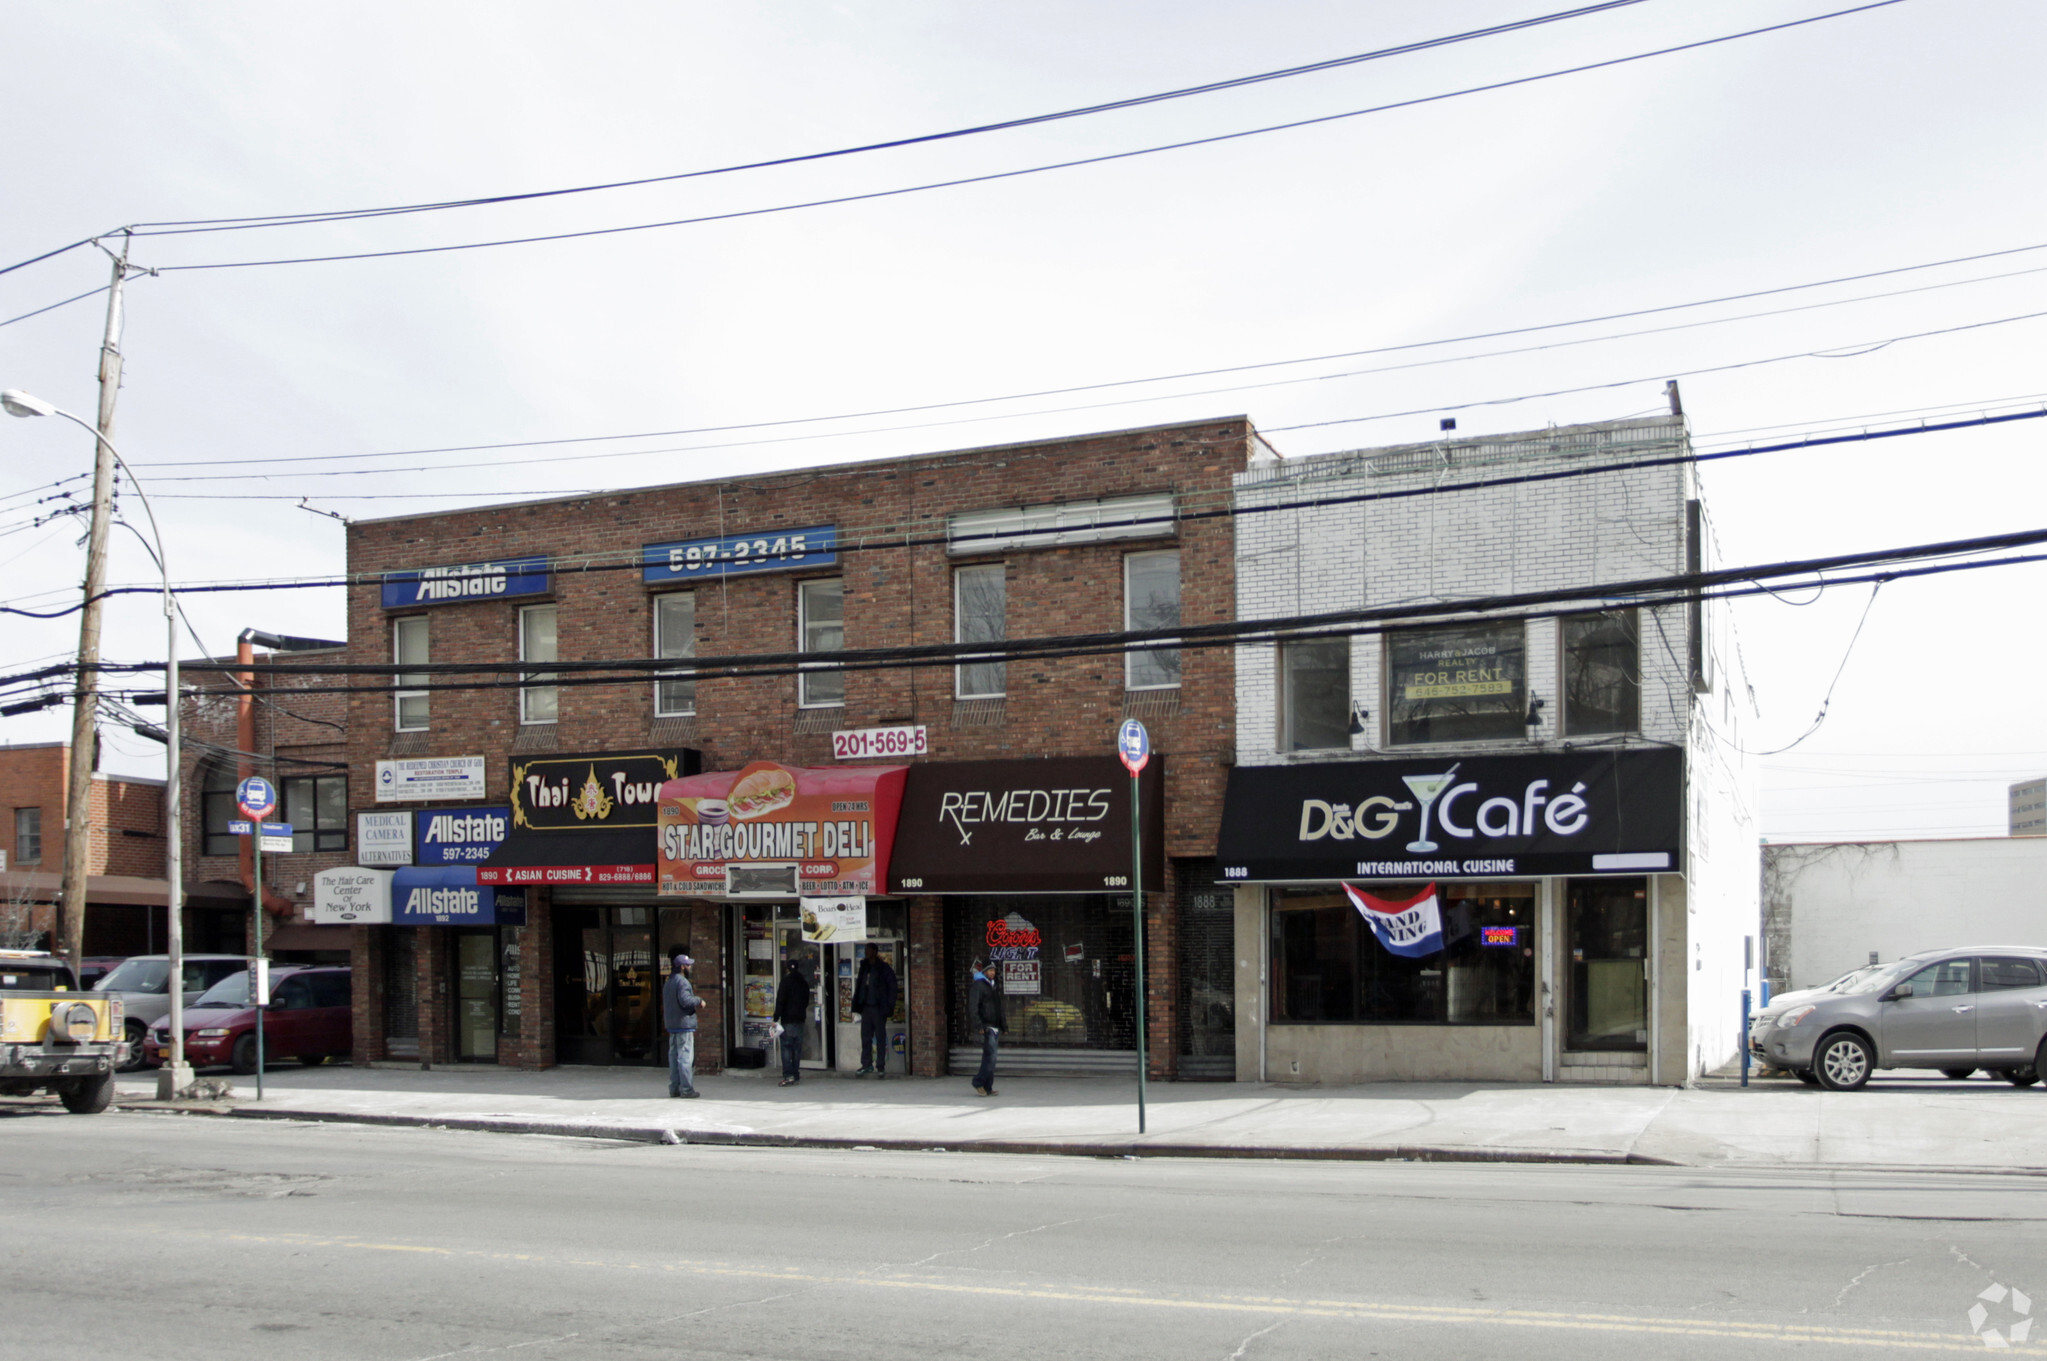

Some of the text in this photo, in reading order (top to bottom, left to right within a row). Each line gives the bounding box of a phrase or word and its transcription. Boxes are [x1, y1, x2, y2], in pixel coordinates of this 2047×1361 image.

[669, 536, 805, 571] 597-2345
[416, 564, 506, 600] Allstate
[1420, 650, 1454, 659] HARRY
[1462, 647, 1496, 656] JACOB
[1438, 658, 1476, 667] REALTY
[1415, 668, 1502, 685] FOR RENT
[836, 730, 925, 756] 201-569-5
[526, 774, 570, 808] Thai
[663, 807, 680, 816] 1890
[832, 802, 847, 812] OPEN
[848, 801, 855, 812] 24
[1299, 779, 1588, 840] D&G Café
[365, 815, 406, 827] MEDICAL
[939, 789, 1112, 845] REMEDIES
[366, 829, 404, 840] CAMERA
[424, 814, 506, 843] Allstate
[664, 820, 870, 860] STAR GOURMET DELI
[1024, 827, 1102, 843] Bar & Lounge
[361, 850, 412, 862] ALTERNATIVES
[443, 847, 490, 860] 597-2345
[806, 865, 834, 874] CORP.
[1224, 867, 1248, 878] 1888
[1358, 860, 1514, 875] INTERNATIONAL CUISINE
[481, 869, 582, 880] 1890 ASIAN CUISINE
[322, 876, 374, 886] The Hair Care
[662, 882, 672, 890] HOT
[679, 882, 692, 890] COLD
[802, 880, 868, 890] BEER LOTTO ATM ICE
[901, 876, 1127, 888] 1890 1890
[334, 886, 362, 895] Center
[404, 887, 478, 914] Allstate
[846, 902, 862, 910] Head
[1194, 896, 1216, 908] 1888
[326, 902, 372, 912] New York
[986, 920, 1042, 948] Coors
[990, 947, 1038, 960] LIGHT
[1010, 964, 1032, 972] FOR
[1006, 972, 1036, 980] RENT
